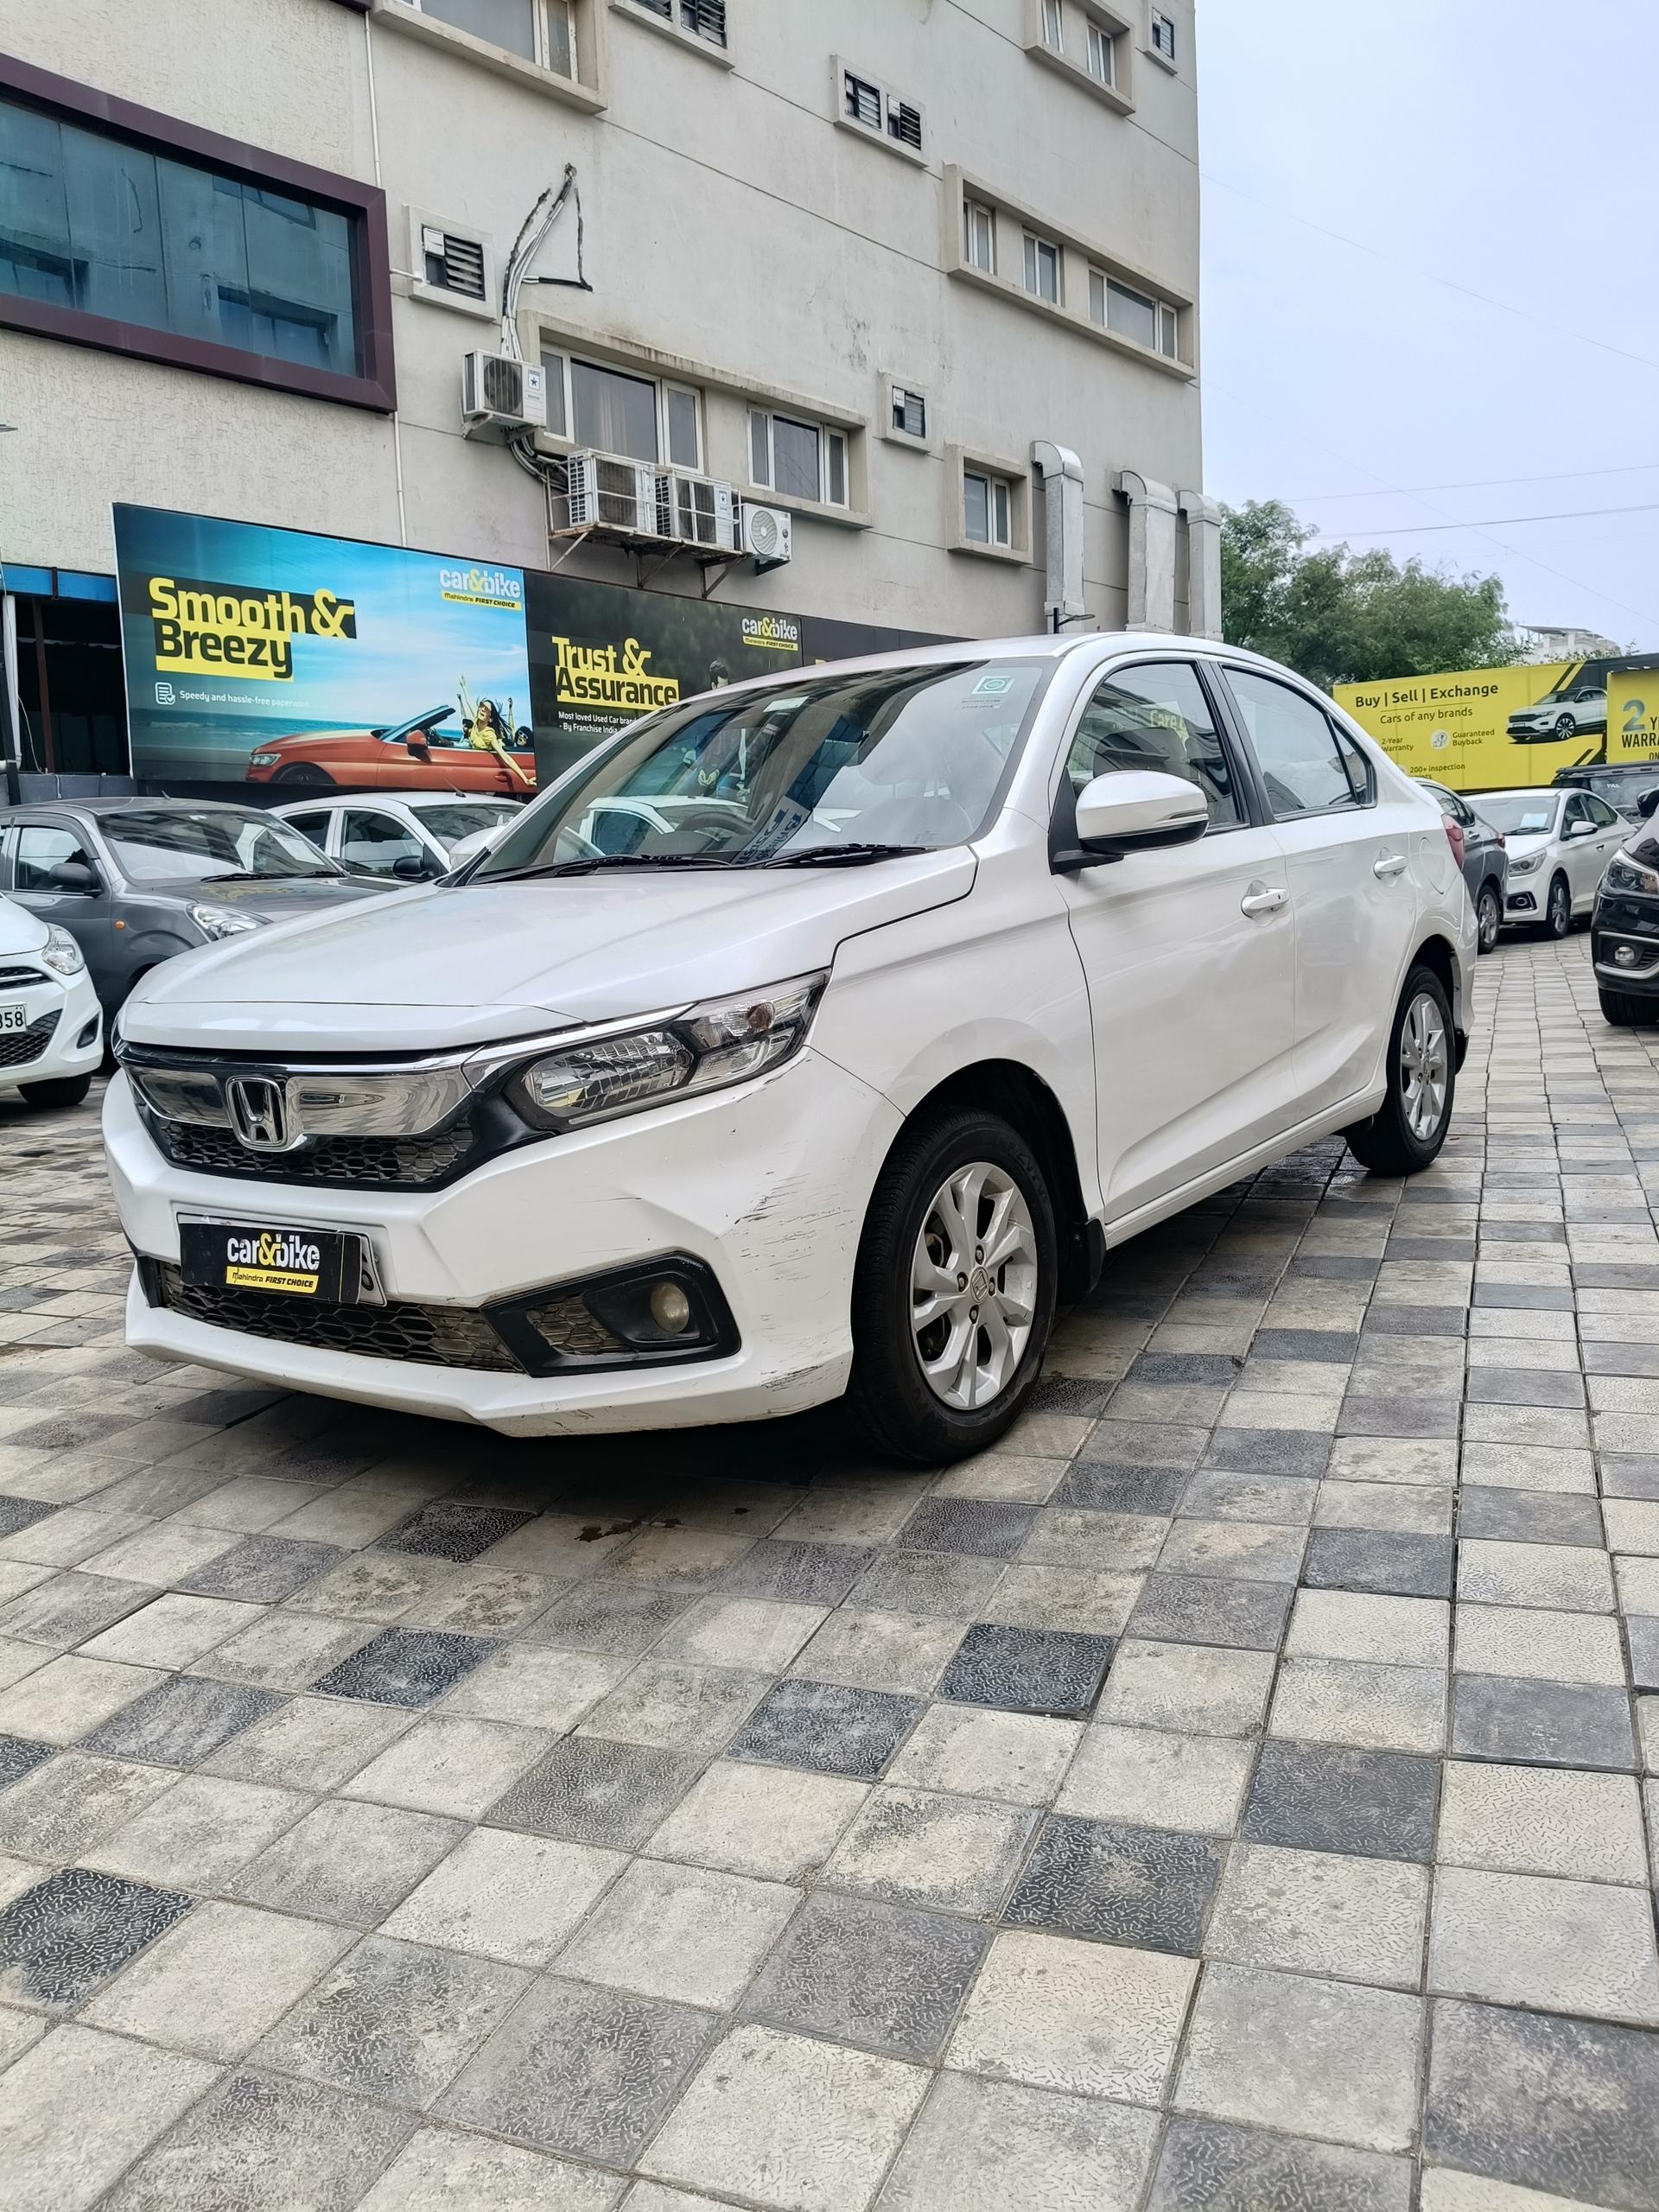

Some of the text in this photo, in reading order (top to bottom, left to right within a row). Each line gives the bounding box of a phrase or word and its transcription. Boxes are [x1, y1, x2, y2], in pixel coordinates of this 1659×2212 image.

[439, 569, 521, 598] car&bike
[149, 577, 354, 639] Smooth &
[444, 593, 473, 602] Mahindra
[493, 600, 515, 608] CHOICE
[741, 617, 798, 640] car&bike
[154, 617, 293, 679] Breezy
[552, 636, 652, 677] Trust &
[179, 690, 210, 702] Speedy
[211, 693, 226, 702] and
[227, 694, 270, 705] hassle-free
[556, 666, 677, 707] Assurance
[1355, 696, 1381, 708] Buy
[1392, 689, 1418, 703] Sell
[1430, 684, 1498, 700] Exchange
[558, 711, 574, 720] Most
[575, 712, 592, 721] loved
[593, 715, 608, 723] Used
[1380, 707, 1473, 724] Cars of any brands
[1622, 699, 1659, 732] 2 Y
[563, 722, 572, 732] By
[573, 723, 602, 733] Franchise
[1452, 729, 1495, 738] Guaranteed
[1452, 738, 1483, 747] Buyback
[226, 1233, 320, 1270] car&bike
[232, 1270, 314, 1287] Mahindra FIRST CHOICE
